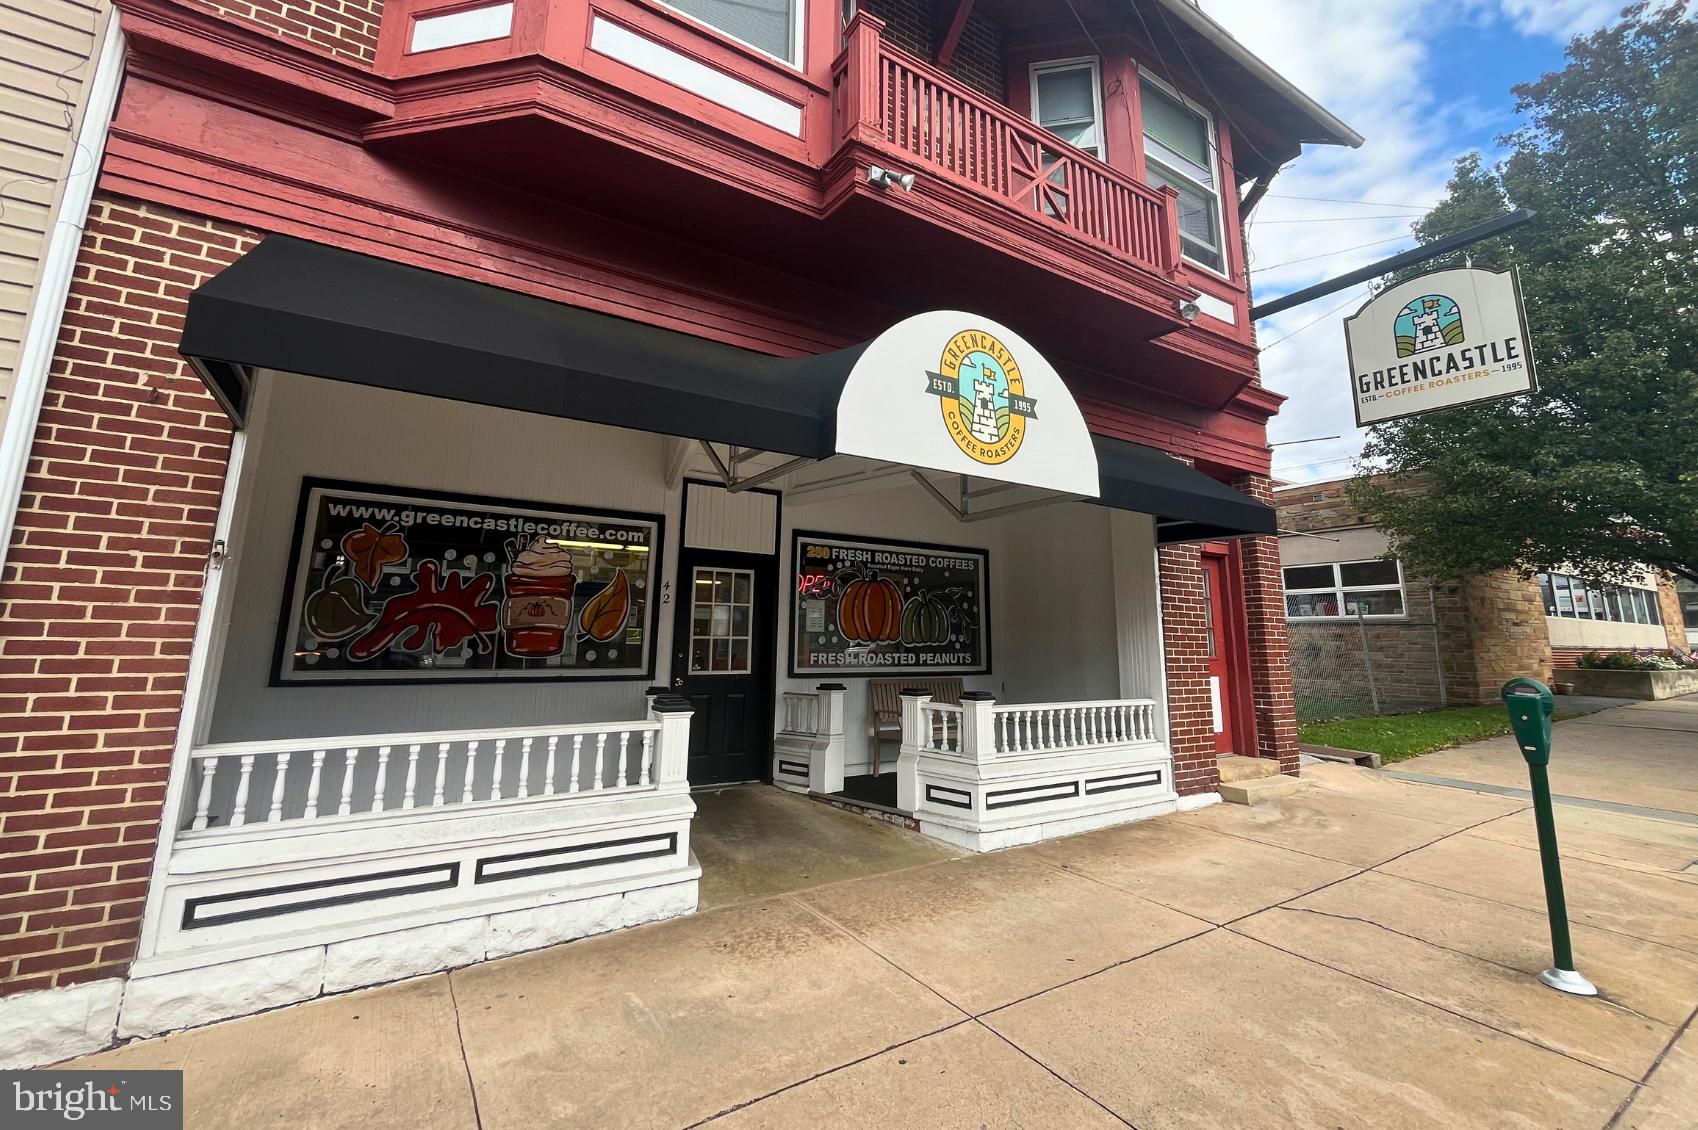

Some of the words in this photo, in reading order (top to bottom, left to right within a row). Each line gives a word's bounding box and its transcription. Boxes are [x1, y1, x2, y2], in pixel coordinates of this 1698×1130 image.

[944, 333, 1020, 384] GREENCASTLE
[1358, 337, 1520, 394] GREENCASTLE
[933, 379, 956, 394] ESTD.
[1014, 400, 1032, 413] 1995
[1385, 384, 1425, 398] COFFEE
[1428, 369, 1490, 389] ROASTERS
[1501, 362, 1523, 373] 1995
[948, 411, 977, 453] COFFEE
[980, 427, 1020, 458] ROASTERS
[328, 503, 644, 543] www.greencastlecoffee.com
[832, 548, 871, 563] FRESH
[875, 552, 926, 567] ROASTED
[929, 557, 975, 570] COFFEES
[810, 652, 854, 665] FRESH
[859, 652, 916, 665] ROASTED
[919, 652, 972, 664] PEANUTS
